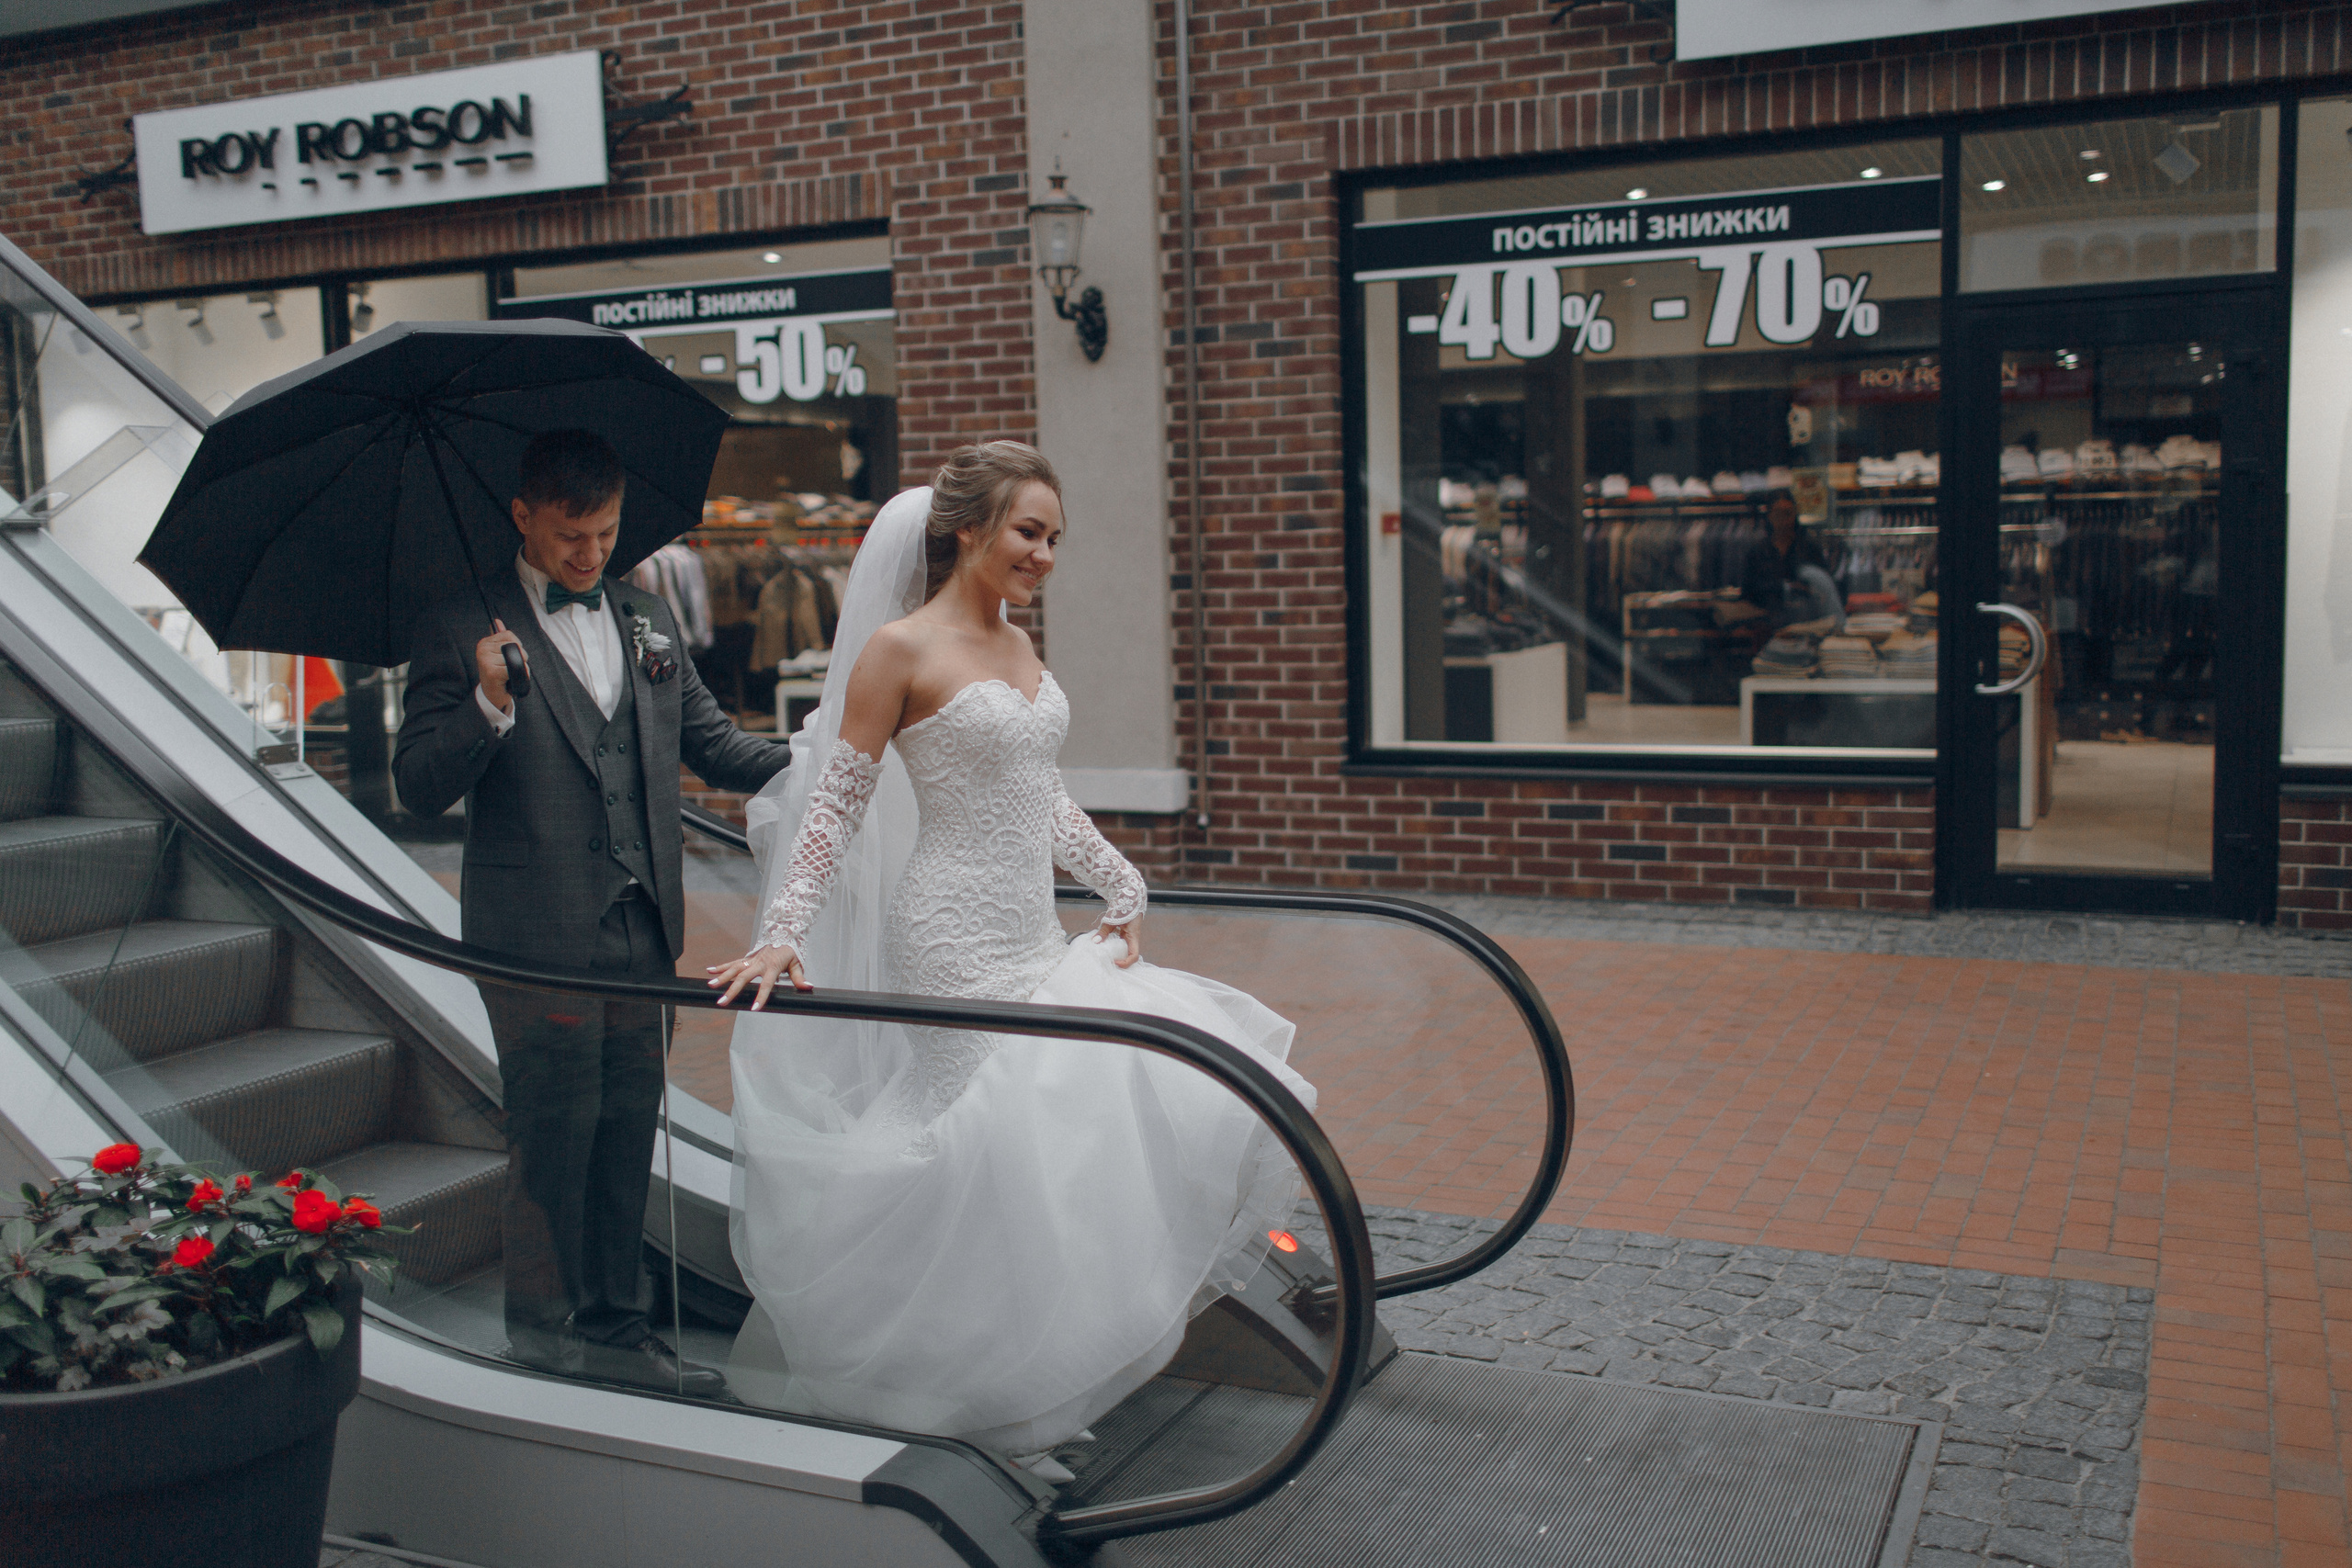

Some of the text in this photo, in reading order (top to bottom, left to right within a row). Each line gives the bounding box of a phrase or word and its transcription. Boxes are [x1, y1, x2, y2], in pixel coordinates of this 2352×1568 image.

[180, 94, 533, 179] ROY ROBSON
[1493, 205, 1790, 253] постійні знижки
[593, 288, 797, 324] постійні знижки
[1408, 266, 1613, 358] -40%
[1860, 368, 1907, 388] ROY
